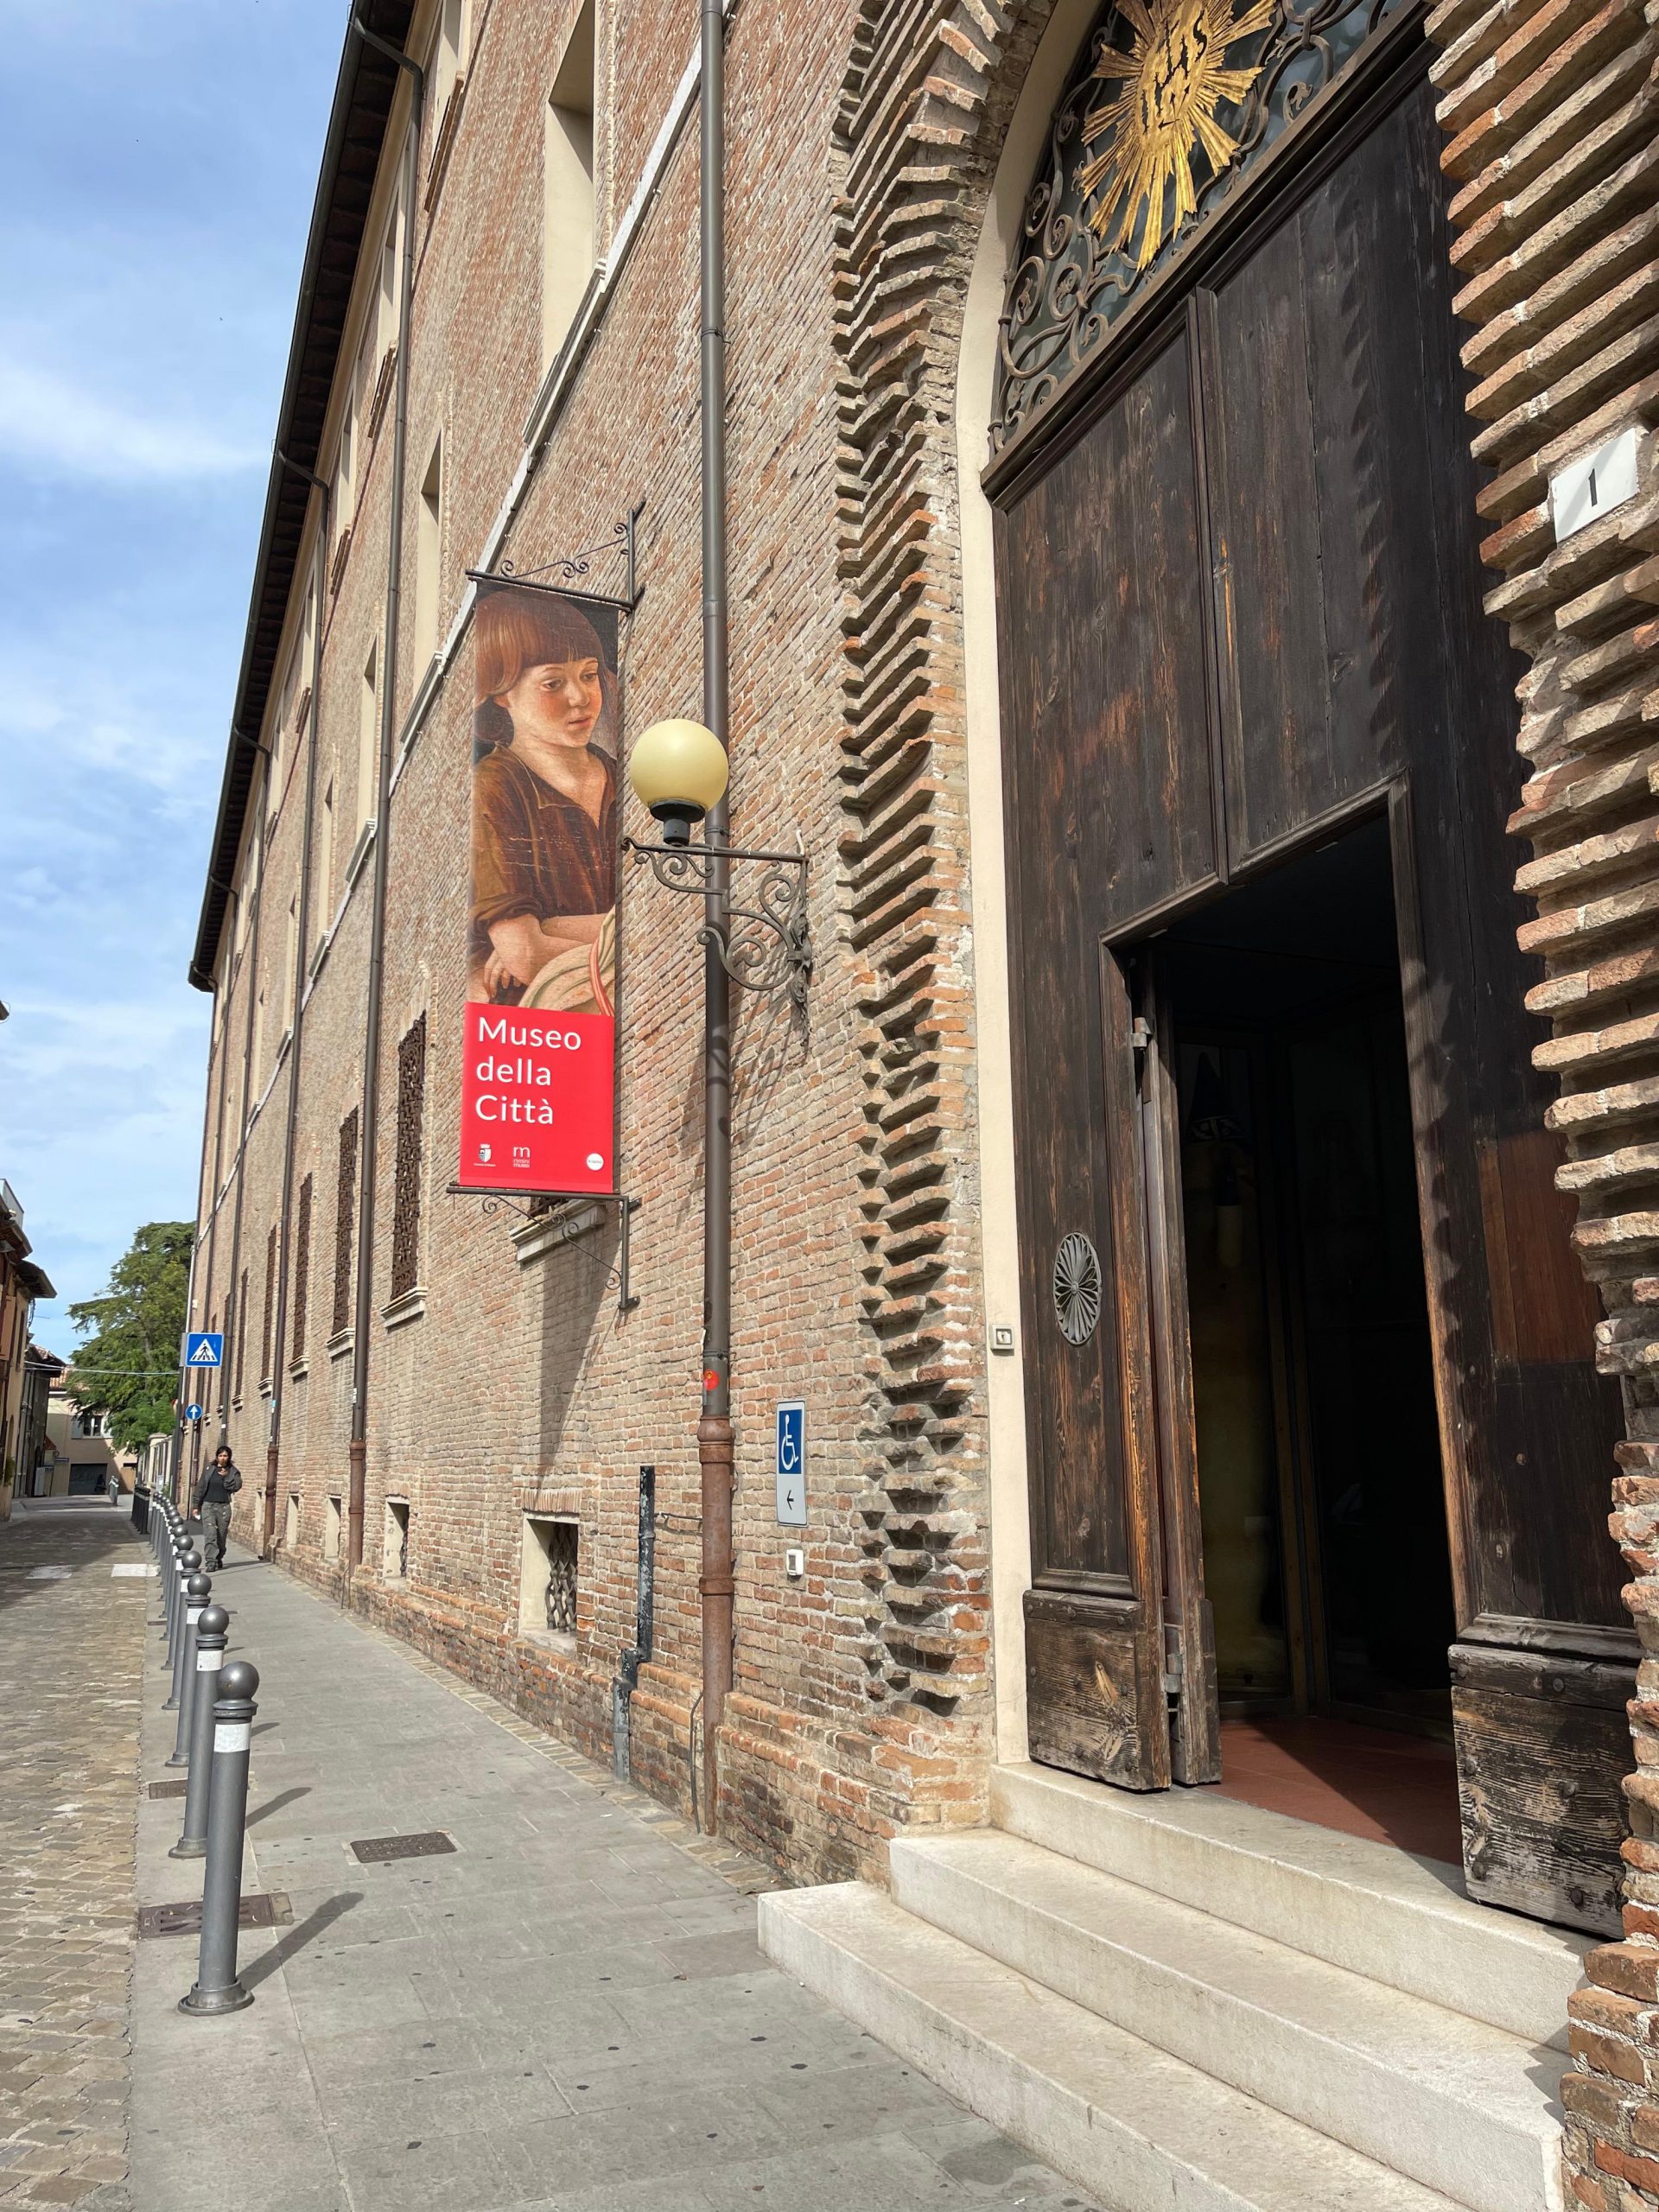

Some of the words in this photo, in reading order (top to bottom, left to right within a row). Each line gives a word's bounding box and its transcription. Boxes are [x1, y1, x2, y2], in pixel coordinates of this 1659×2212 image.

[1588, 467, 1598, 507] 1
[478, 1016, 582, 1051] Museo
[475, 1055, 551, 1086] della
[475, 1094, 553, 1124] Città
